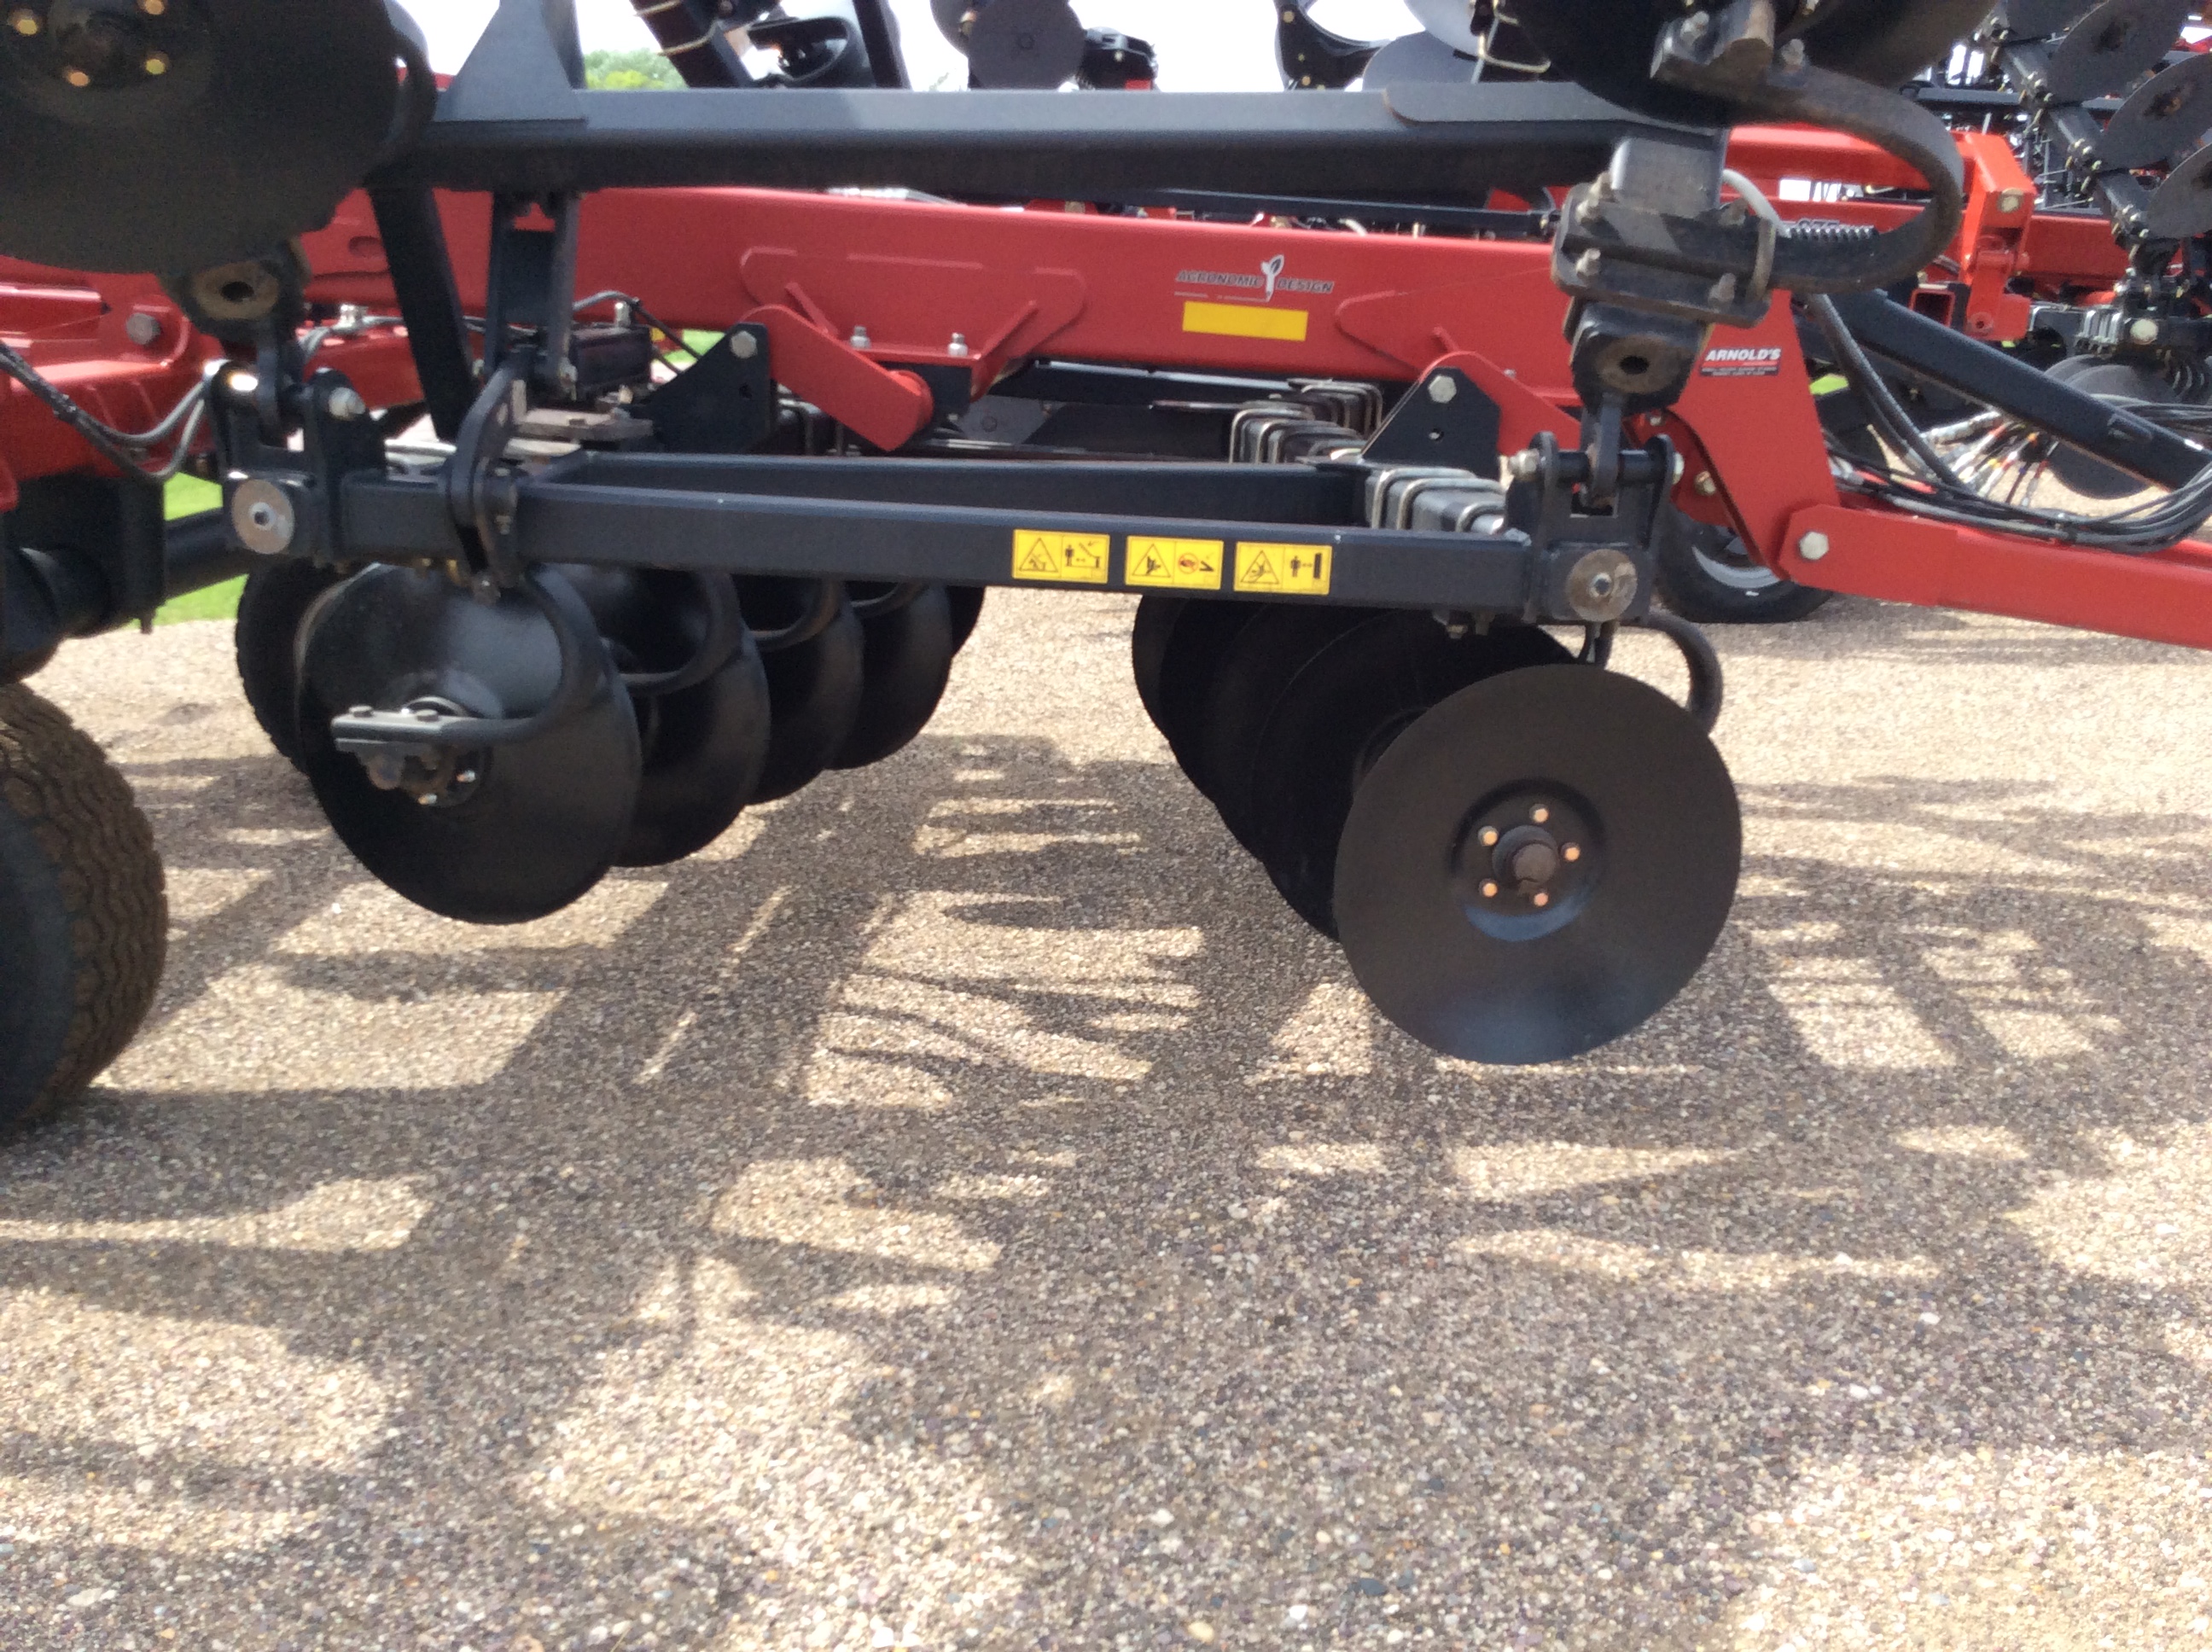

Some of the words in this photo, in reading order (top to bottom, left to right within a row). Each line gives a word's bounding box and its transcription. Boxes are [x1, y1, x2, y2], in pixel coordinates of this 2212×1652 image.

[1176, 270, 1264, 288] AGRONOMIC
[1277, 276, 1335, 294] DESIGN
[1705, 348, 1781, 361] ARNOLD'S
